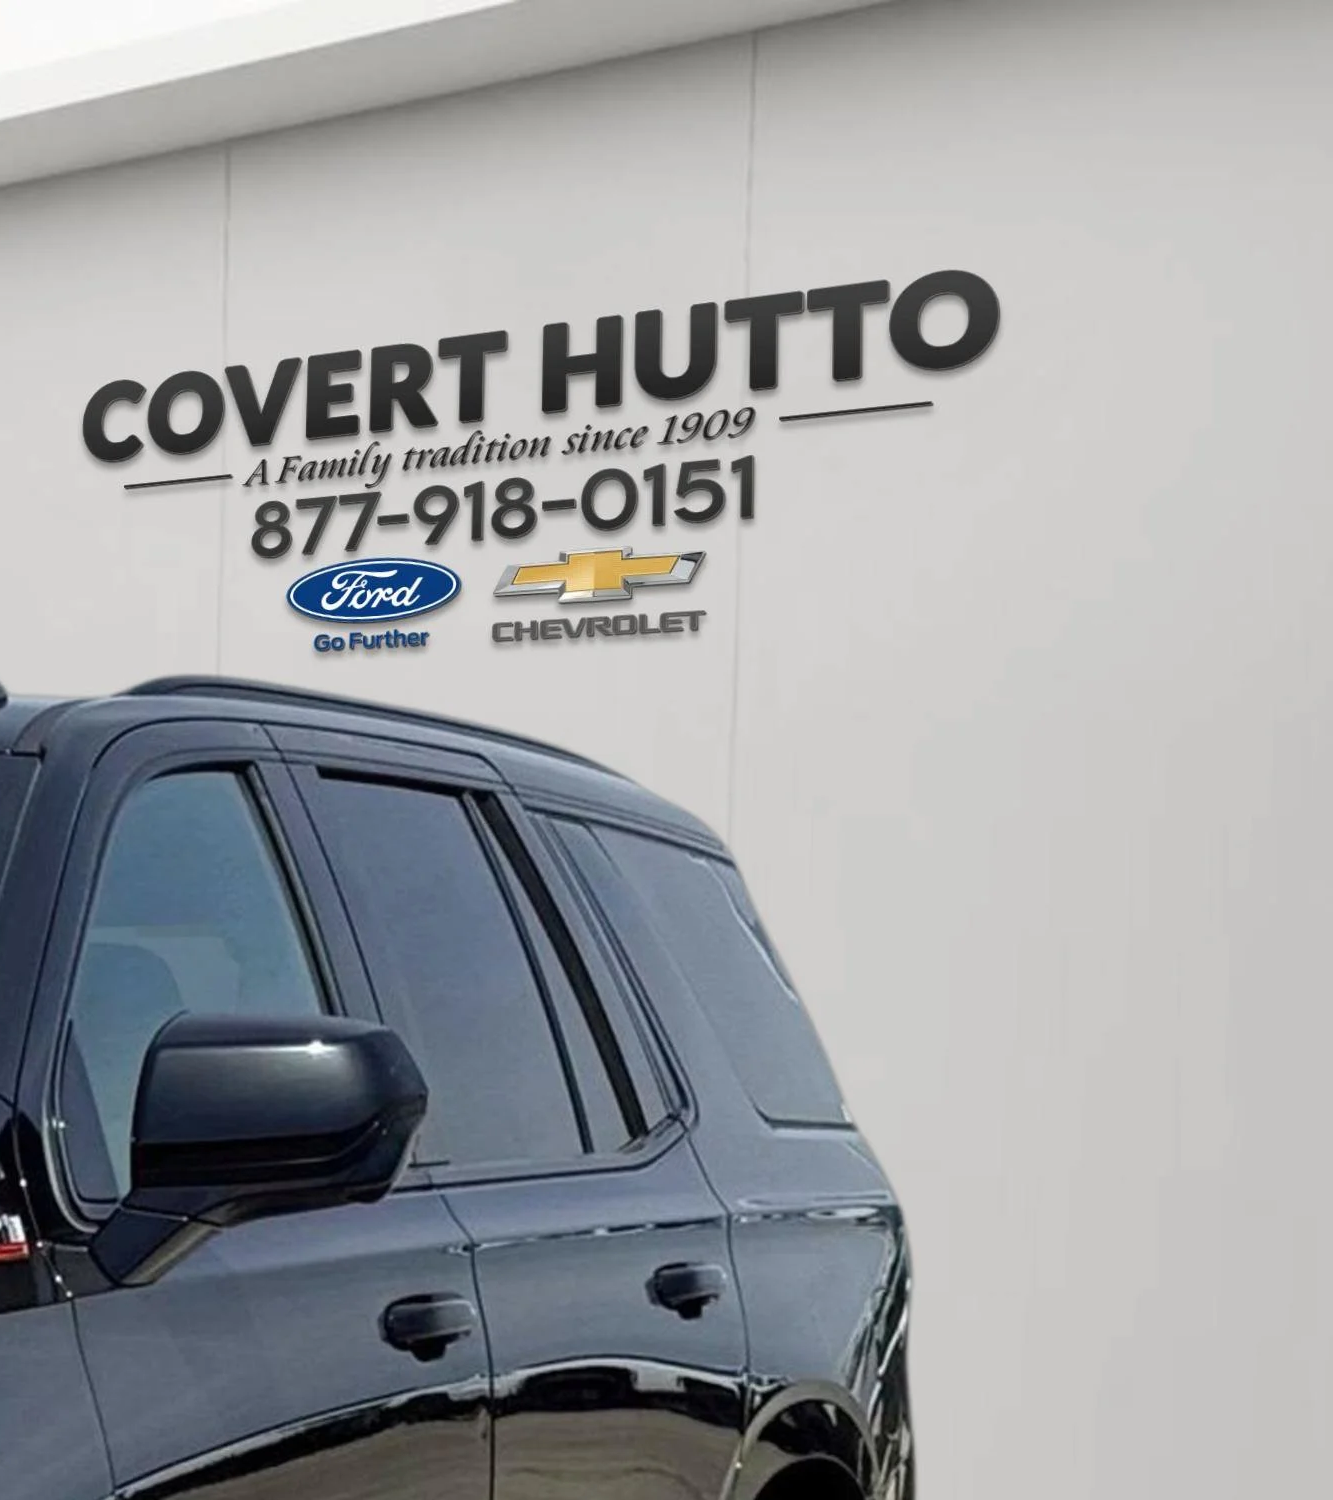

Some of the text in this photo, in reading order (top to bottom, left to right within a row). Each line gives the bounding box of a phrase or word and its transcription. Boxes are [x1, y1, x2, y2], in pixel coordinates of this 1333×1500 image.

[81, 268, 1002, 466] COVERT HUTTO
[242, 405, 757, 490] A Family tradition since 1909
[249, 453, 756, 561] 877-918-0151
[320, 565, 422, 614] Ford
[312, 626, 431, 655] Go Further
[490, 609, 708, 644] CHEVROLET
